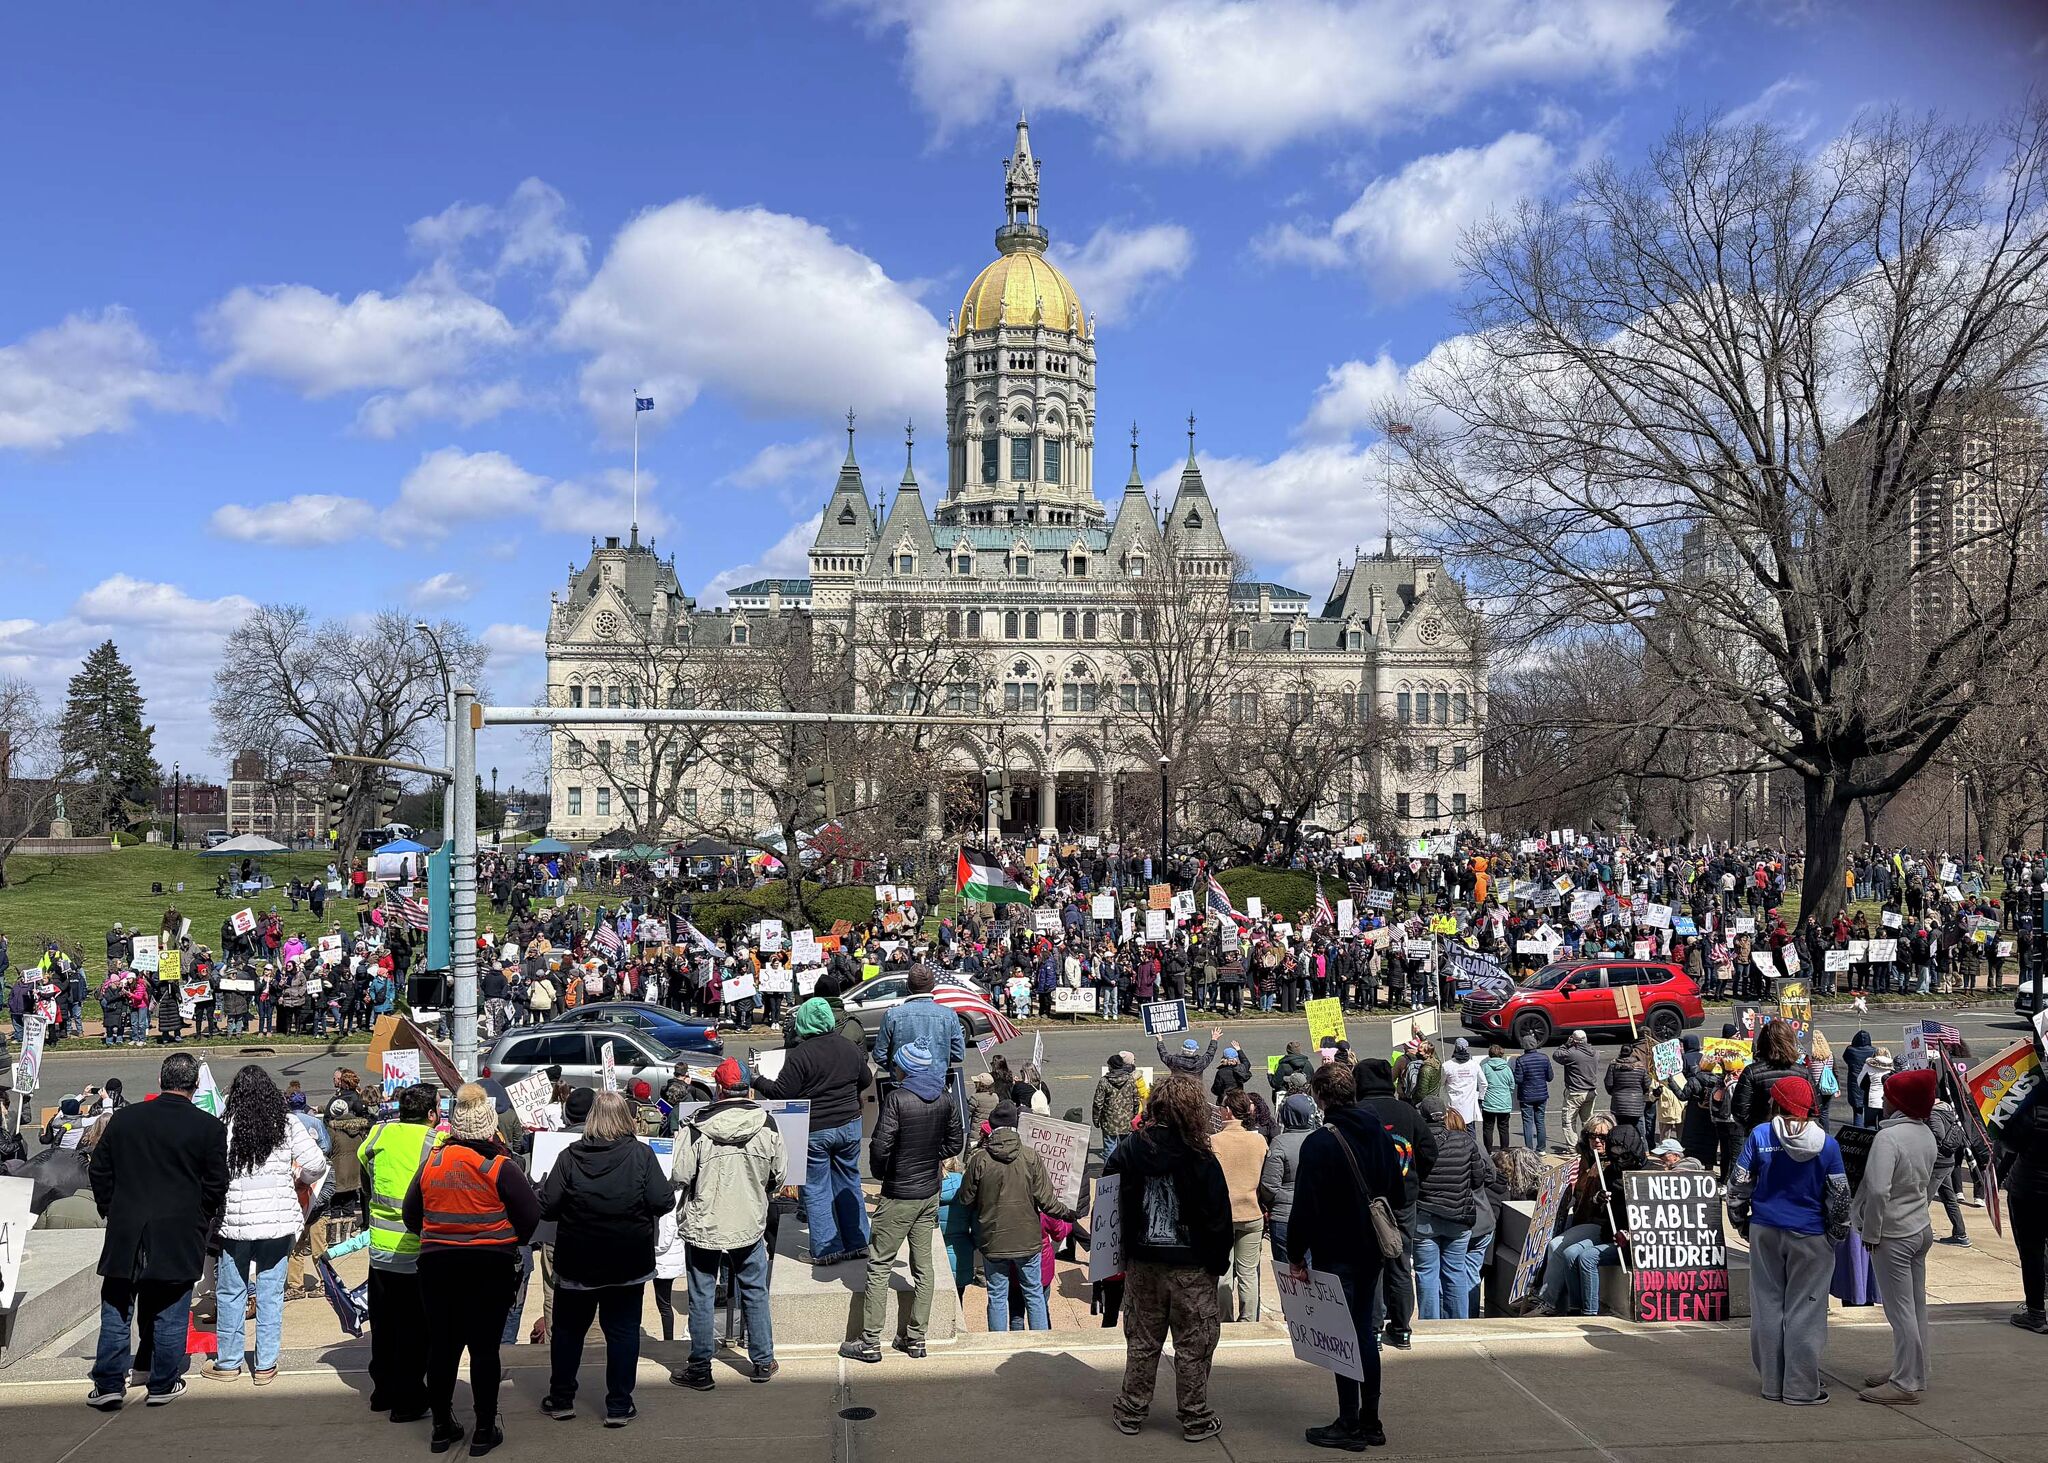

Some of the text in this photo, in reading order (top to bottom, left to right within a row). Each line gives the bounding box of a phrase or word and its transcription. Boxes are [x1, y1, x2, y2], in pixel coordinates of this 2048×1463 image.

[1149, 1002, 1178, 1013] VETERANS
[1151, 1011, 1179, 1022] AGAINST
[1152, 1020, 1180, 1033] TRUMP
[508, 1073, 549, 1100] HATE
[1981, 1065, 2016, 1100] NO
[514, 1098, 525, 1108] IS
[530, 1085, 552, 1102] CHOICE
[526, 1098, 548, 1112] OF THE
[1988, 1071, 2040, 1130] KINGS
[1031, 1128, 1074, 1146] END THE
[1034, 1142, 1066, 1158] COVER
[1632, 1176, 1717, 1200] I NEED TO
[1627, 1203, 1708, 1230] BE ABLE
[1638, 1230, 1718, 1246] TO TELL MY
[1634, 1244, 1725, 1268] CHILDREN
[1278, 1270, 1344, 1306] STOP THE STEAL
[1635, 1270, 1728, 1292] I DID NOT STAY
[1305, 1304, 1314, 1316] OF
[1640, 1292, 1728, 1321] SILENT
[1291, 1320, 1355, 1364] OUR DEMOCRACY
